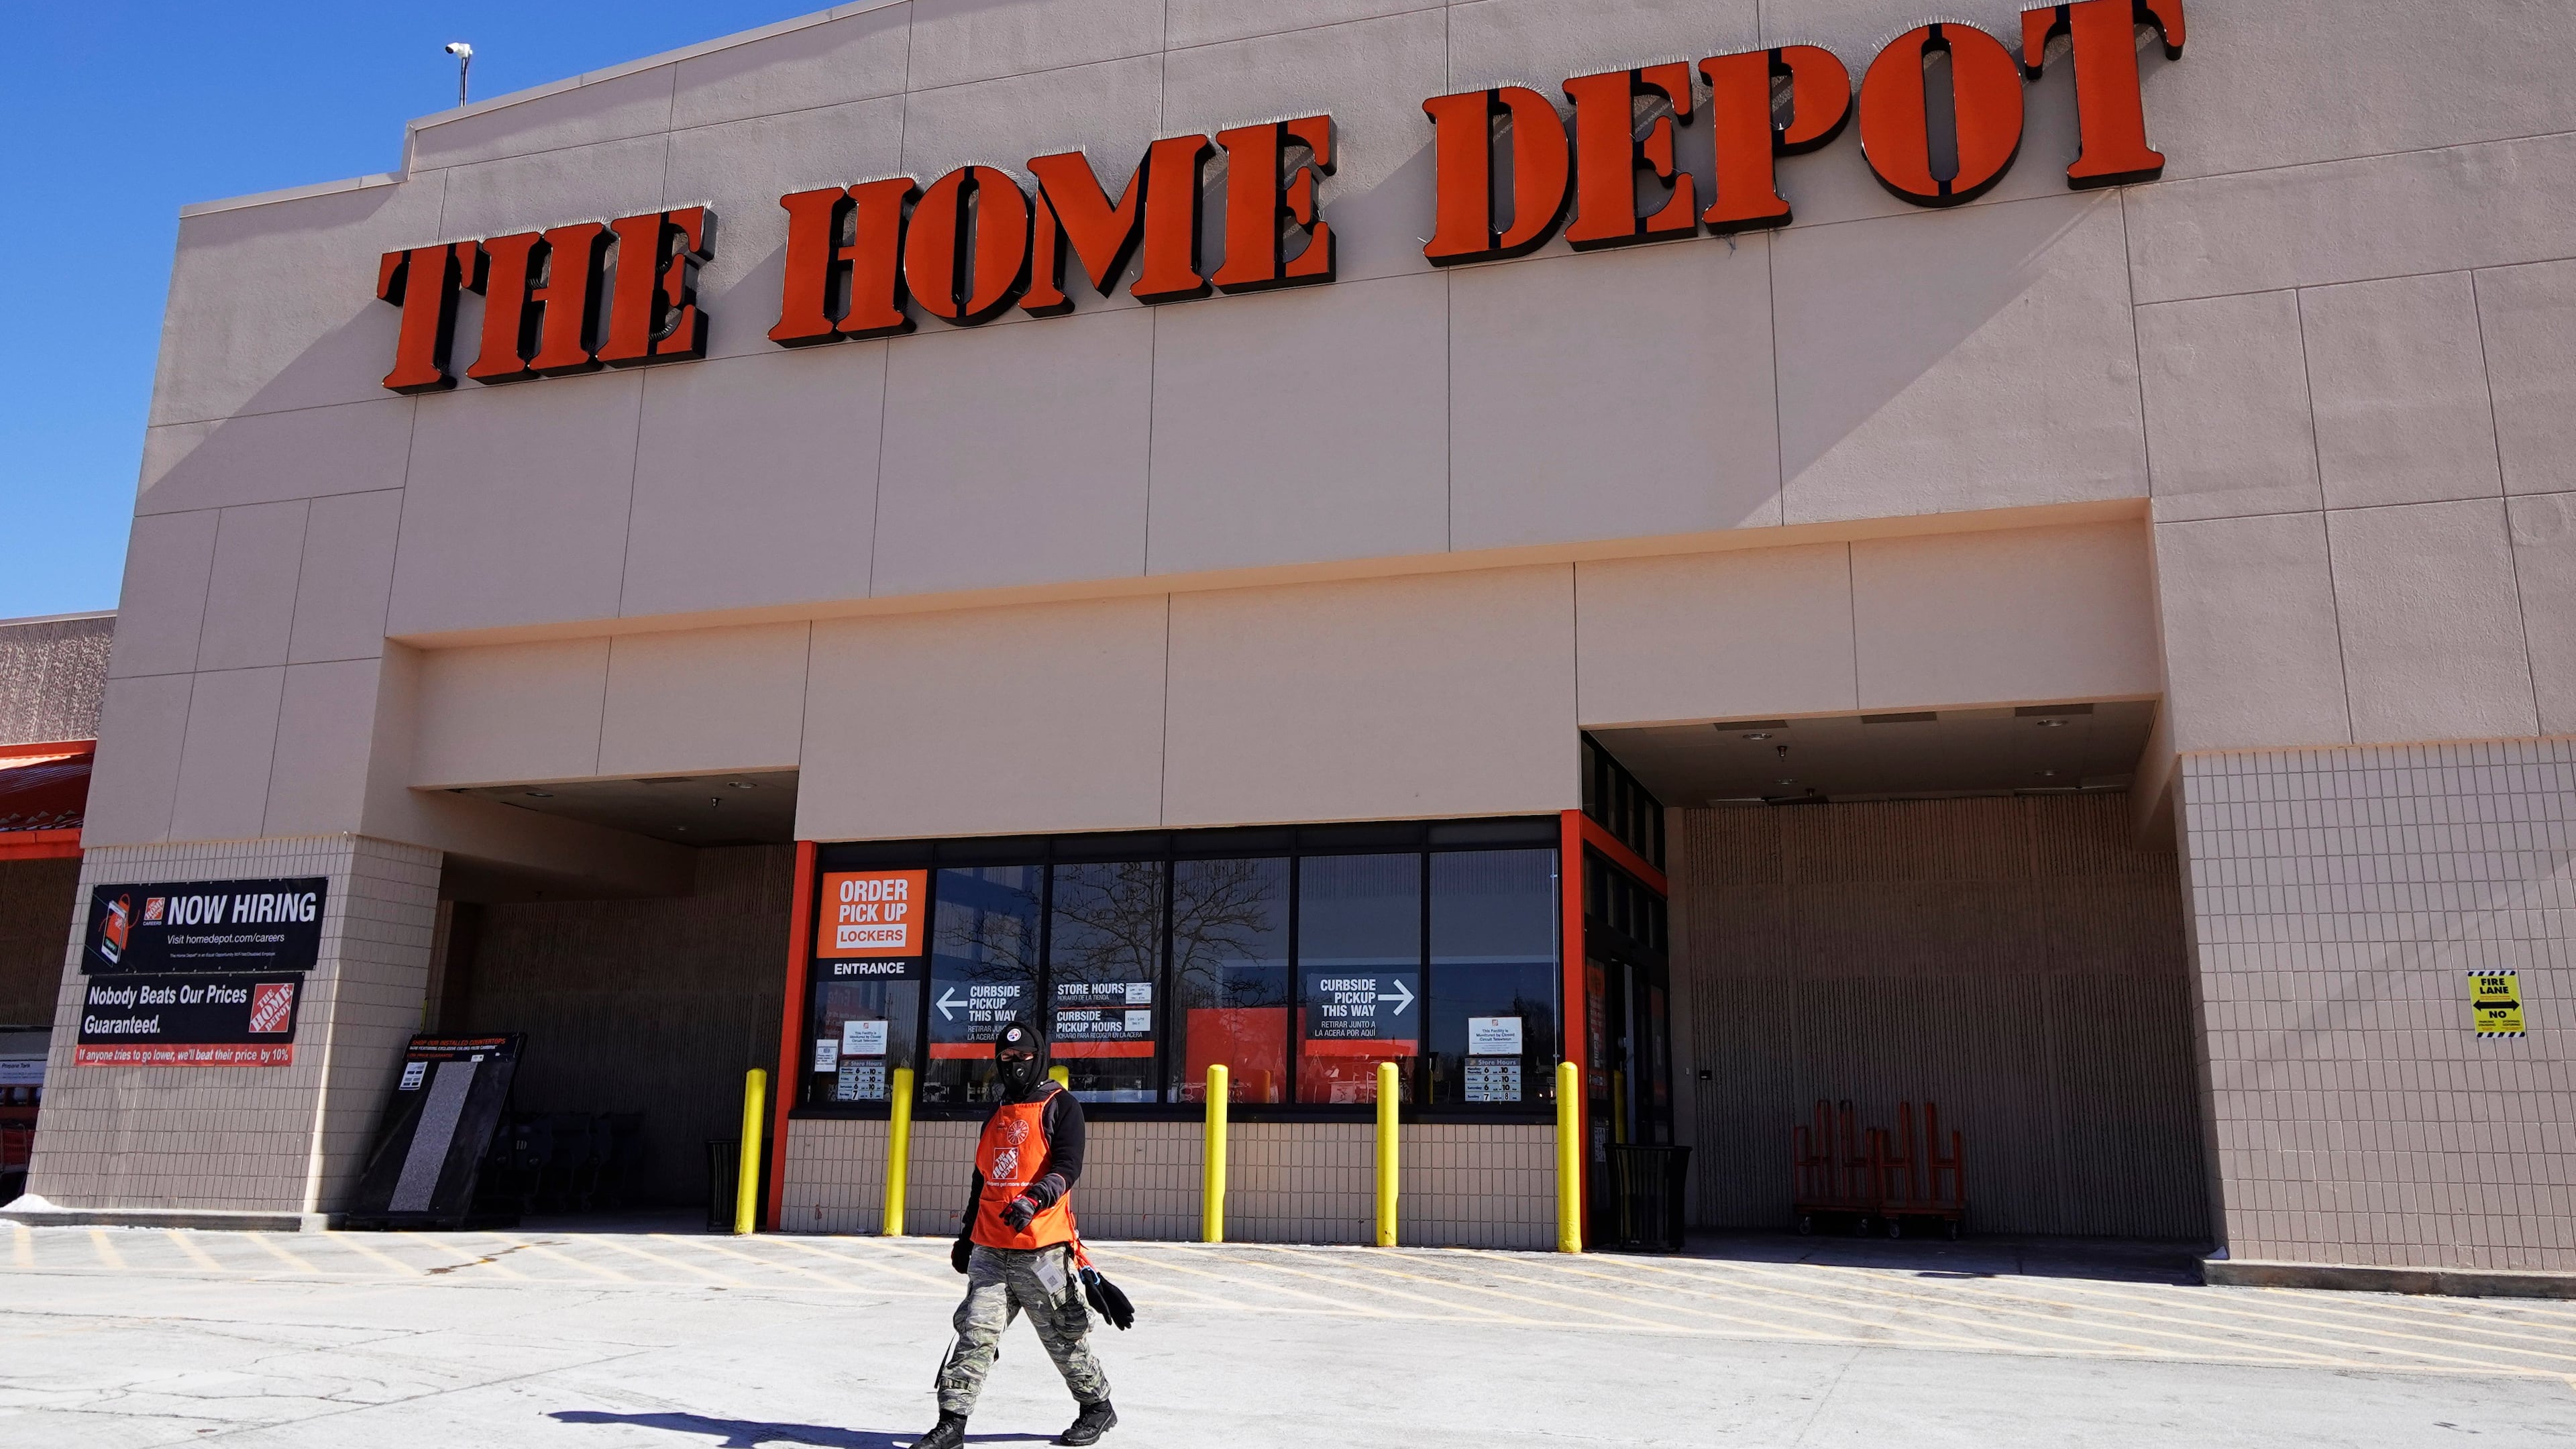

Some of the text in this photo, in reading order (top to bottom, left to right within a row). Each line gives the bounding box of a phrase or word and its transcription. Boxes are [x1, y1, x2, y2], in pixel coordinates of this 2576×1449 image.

[377, 0, 2187, 394] THE HOME DEPOT
[840, 879, 908, 902] ORDER
[167, 892, 317, 926] NOW HIRING
[839, 903, 907, 922] PICK UP
[168, 932, 284, 945] Visit homedepot.com/careers
[841, 930, 903, 942] LOCKERS
[835, 962, 904, 975] ENTRANCE
[1320, 979, 1376, 991] CURBSIDE
[2481, 978, 2505, 986] FIRE
[970, 985, 1020, 997] CURBSIDE
[1057, 983, 1089, 996] STORE
[1092, 983, 1124, 994] HOURS
[2479, 986, 2509, 994] LANE
[89, 985, 247, 1009] Nobody Beats Our Prices
[258, 989, 274, 1008] THE
[1335, 992, 1375, 1004] PICKUP
[251, 983, 292, 1032] HOME
[969, 998, 1006, 1009] PICKUP
[264, 1002, 290, 1032] DEPOT
[969, 1010, 1017, 1021] THIS WAY
[1057, 1010, 1101, 1021] CURBSIDE
[1322, 1005, 1376, 1017] THIS WAY
[2489, 1010, 2507, 1018] NO
[85, 1014, 160, 1034] Guaranteed.
[1056, 1022, 1122, 1032] PICKUP HOURS
[1361, 1028, 1375, 1036] AQUÍ
[79, 1049, 288, 1063] If anyone tries to go lower, we'll beat their price by 10%
[853, 1091, 857, 1099] 7
[995, 1151, 1006, 1163] THE
[993, 1148, 1018, 1179] HOME
[1001, 1159, 1018, 1179] DEPOT
